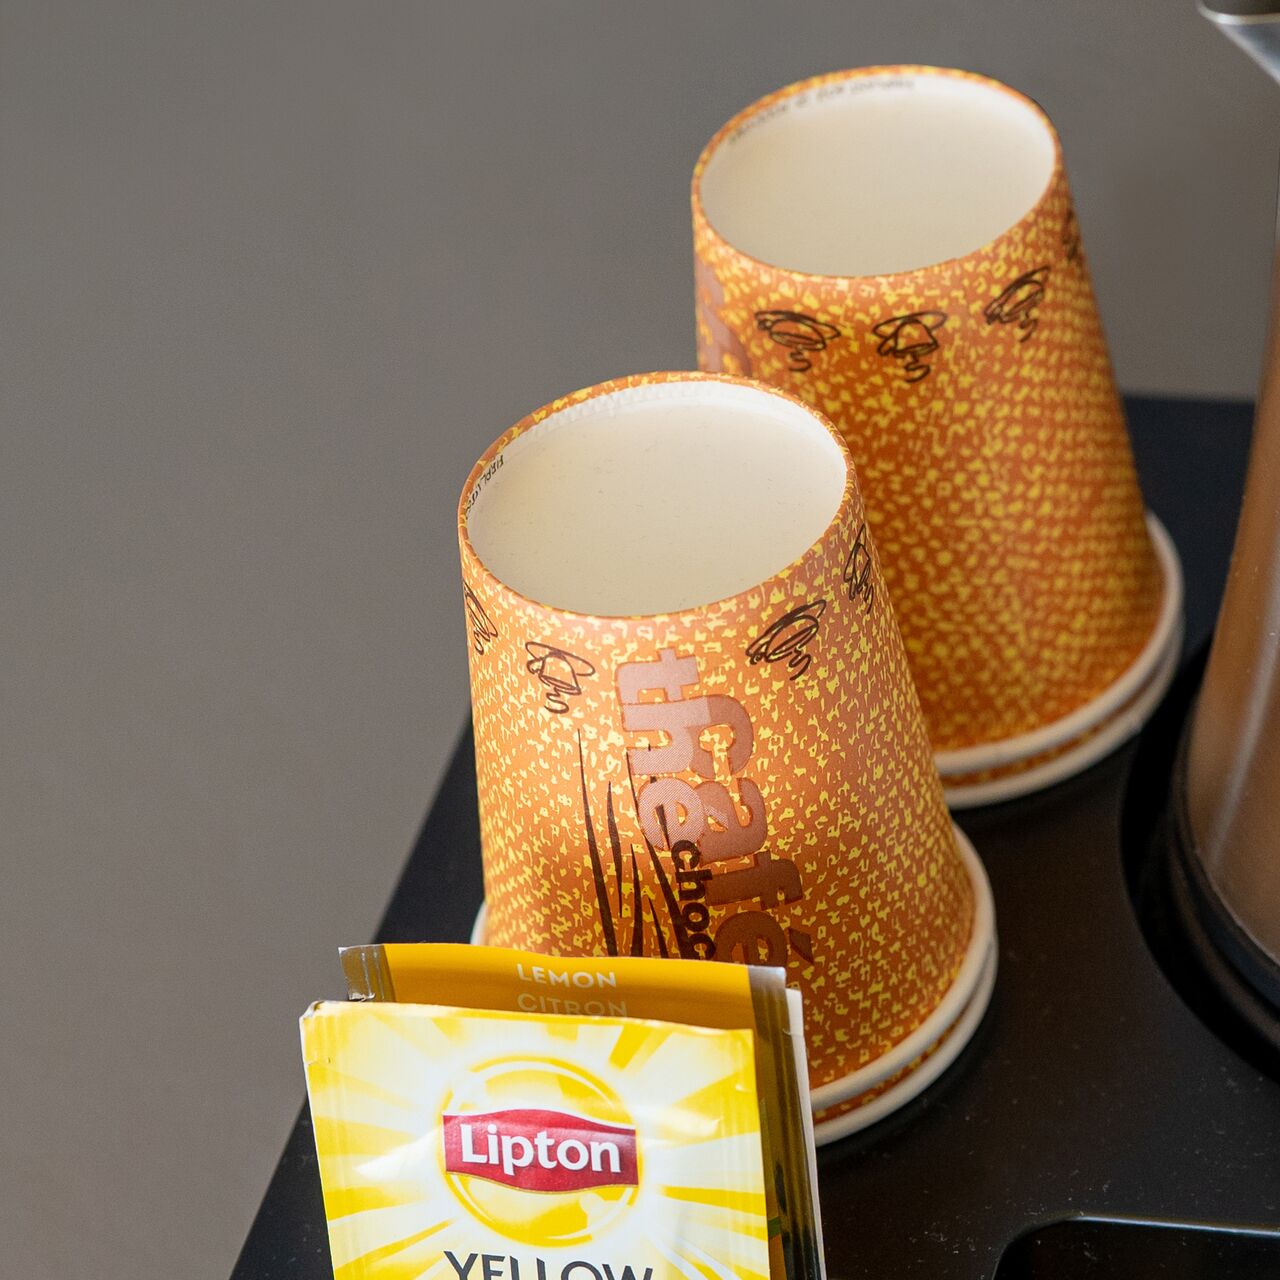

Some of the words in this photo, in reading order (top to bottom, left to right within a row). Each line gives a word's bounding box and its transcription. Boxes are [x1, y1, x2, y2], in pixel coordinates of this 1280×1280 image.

[516, 962, 617, 989] LEMON
[517, 992, 628, 1018] CITRON
[459, 1123, 622, 1178] Lipton
